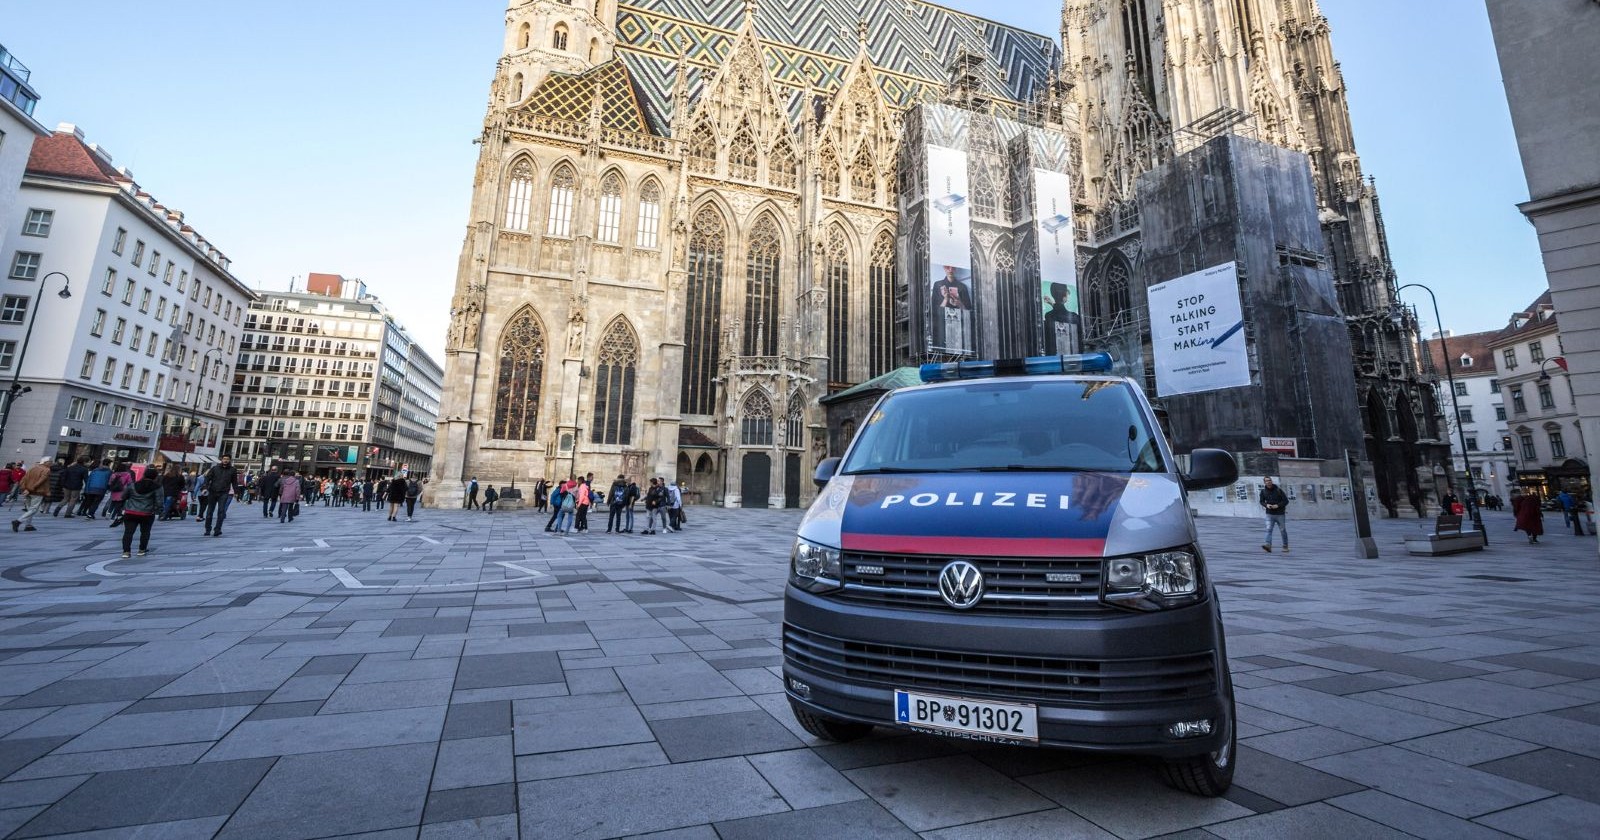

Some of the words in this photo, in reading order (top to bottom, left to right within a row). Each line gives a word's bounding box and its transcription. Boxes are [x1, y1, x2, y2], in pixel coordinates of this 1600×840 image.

[1177, 294, 1205, 309] STOP
[1170, 306, 1216, 324] TALKING
[1178, 321, 1210, 336] START
[880, 492, 1069, 510] POLIZEI
[900, 710, 907, 718] A
[916, 699, 941, 722] BP
[958, 704, 1024, 733] 91302
